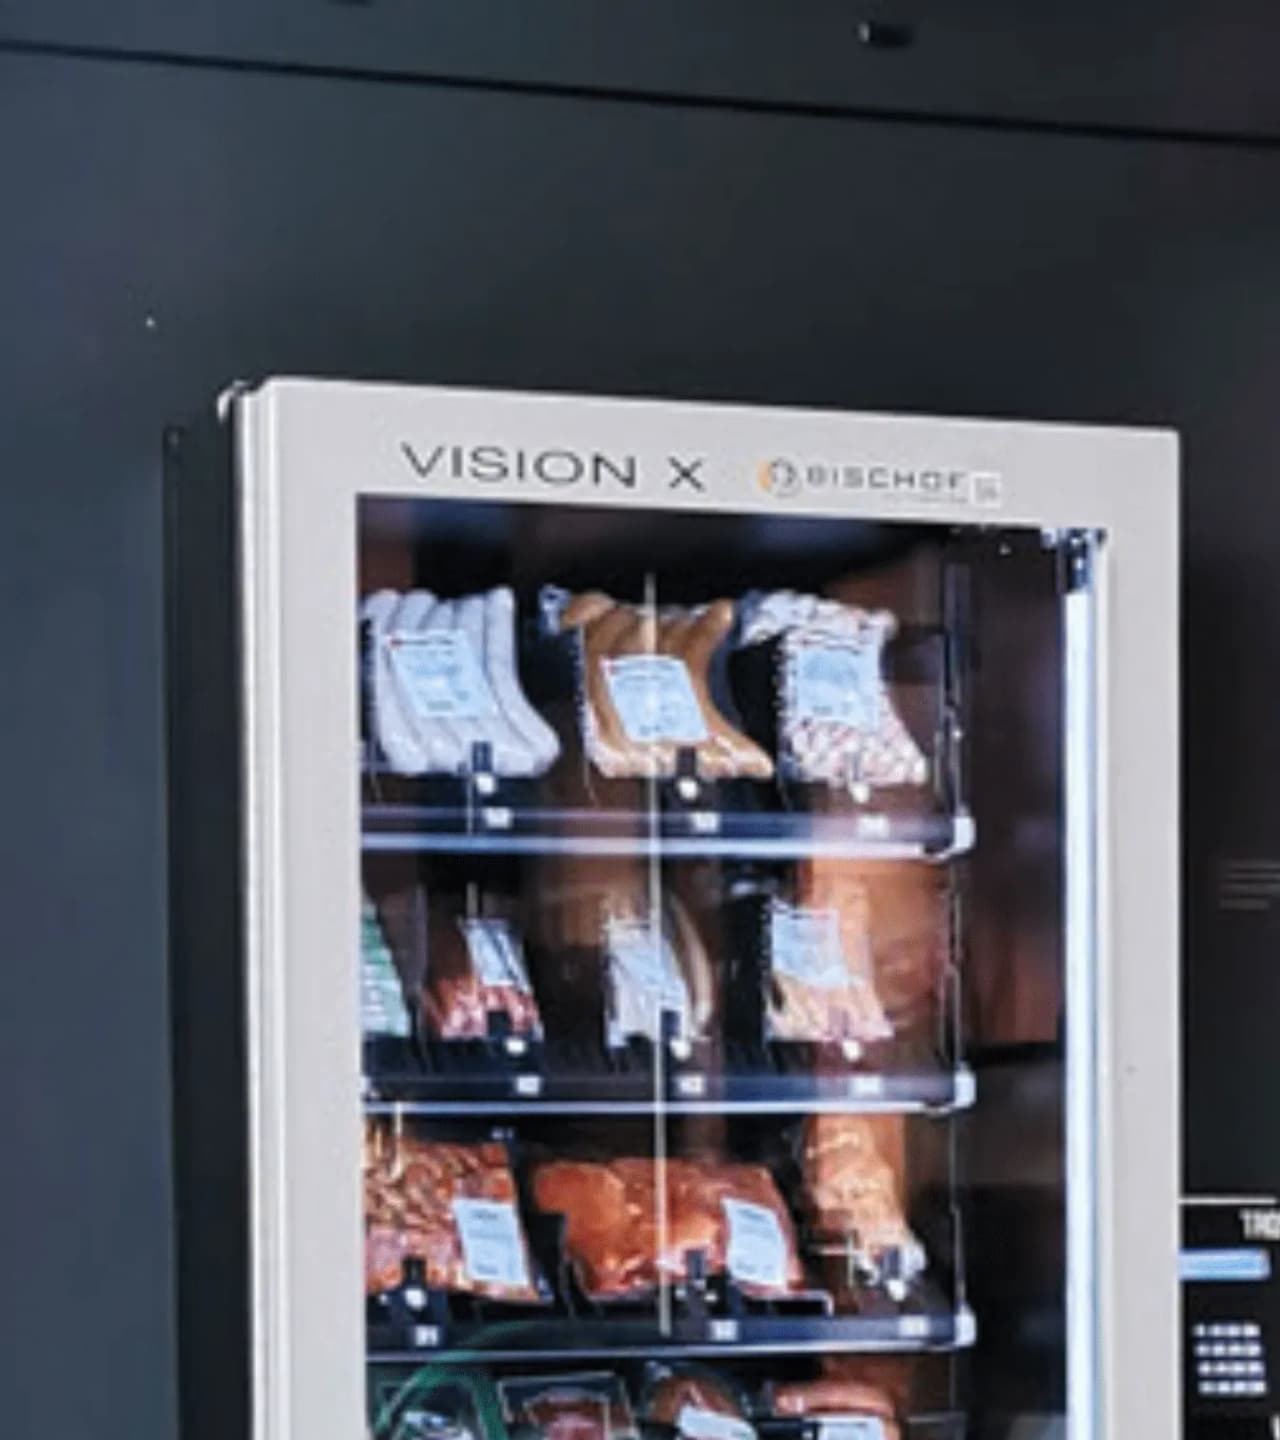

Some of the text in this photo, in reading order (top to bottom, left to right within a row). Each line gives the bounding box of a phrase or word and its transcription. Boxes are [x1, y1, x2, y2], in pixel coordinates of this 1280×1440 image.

[401, 443, 704, 491] VISION X
[806, 465, 968, 490] BISCHOF
